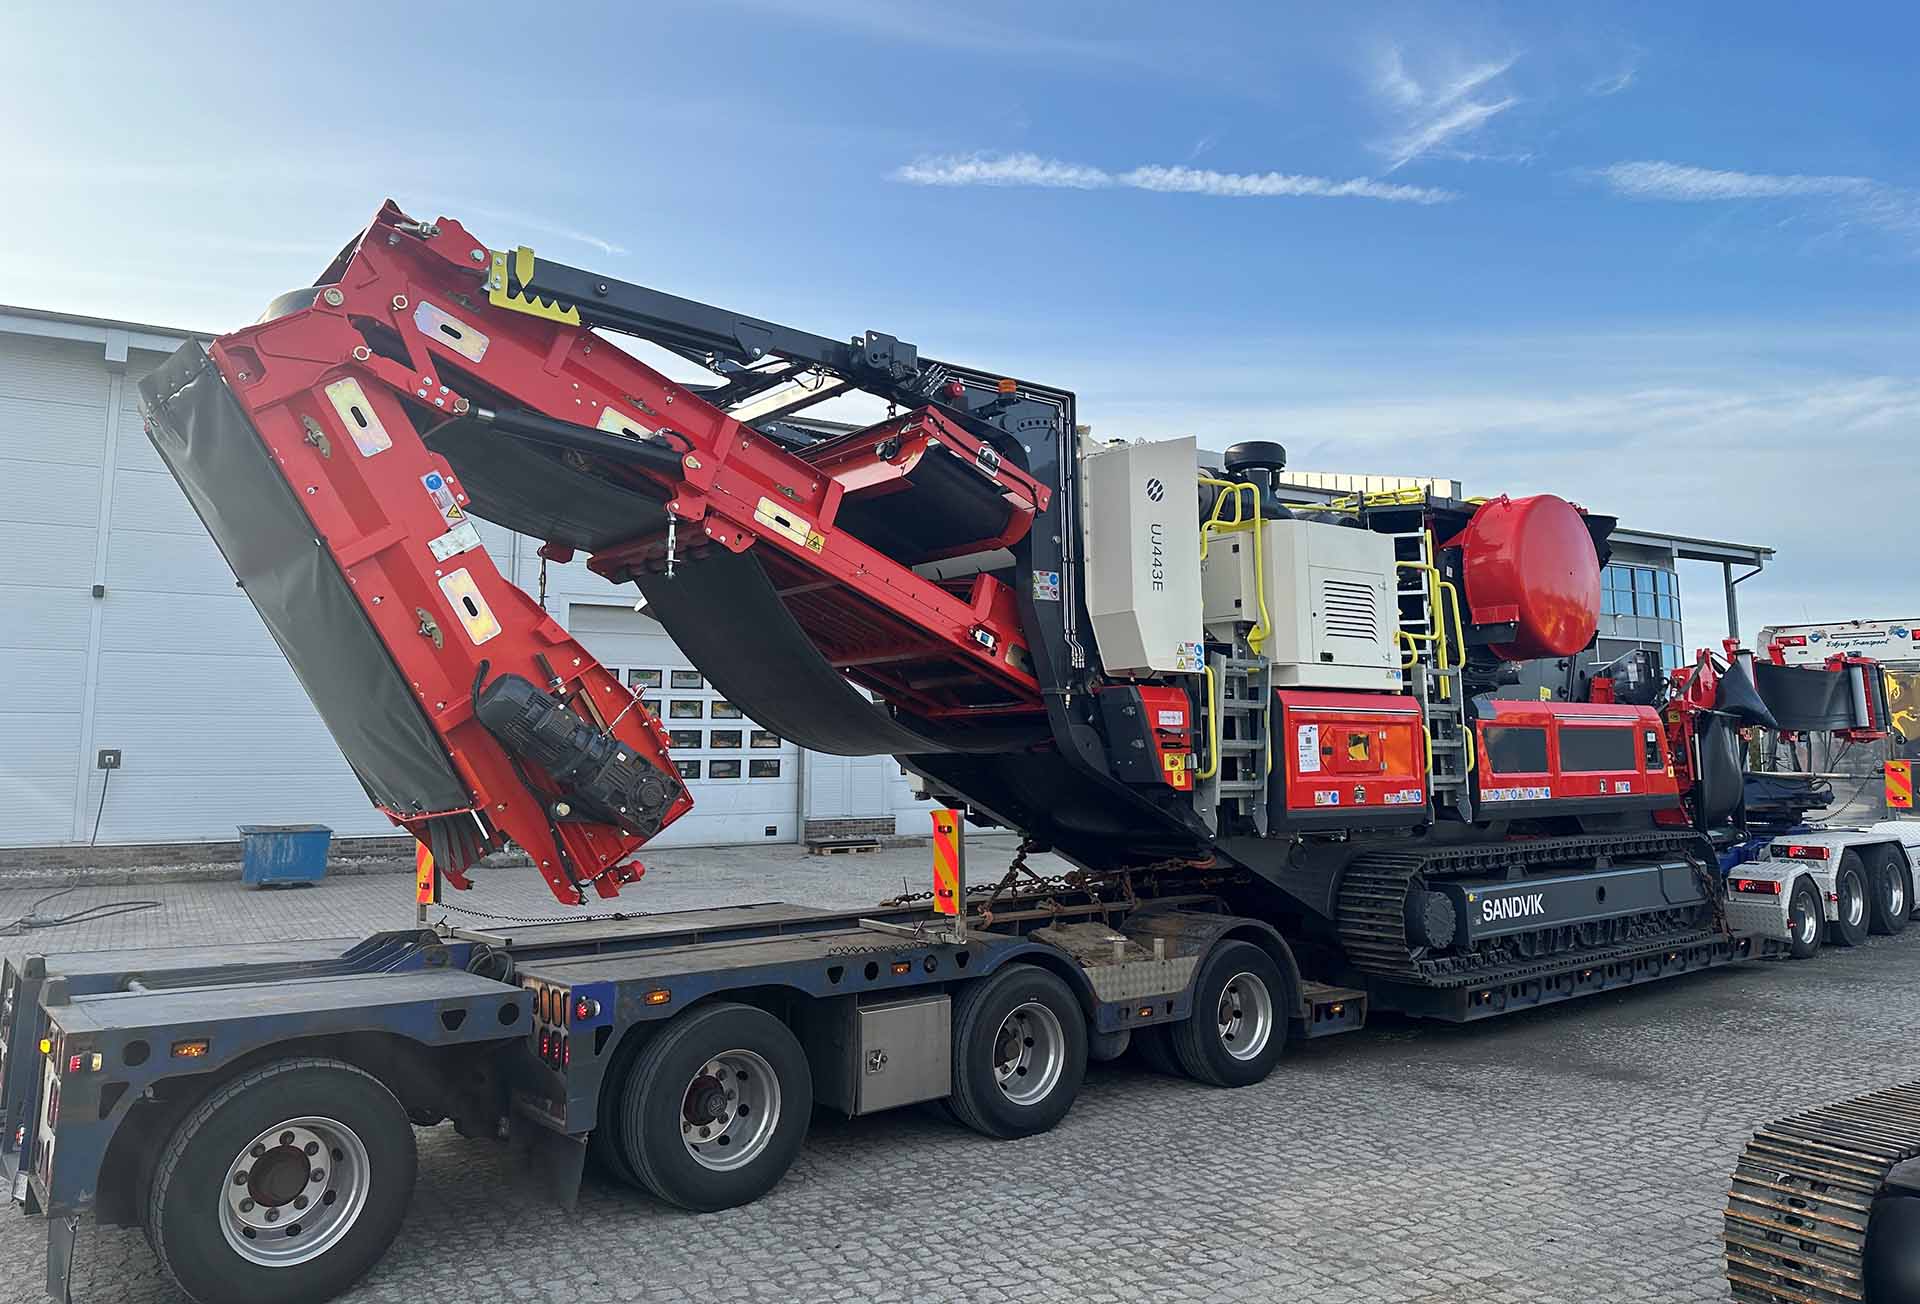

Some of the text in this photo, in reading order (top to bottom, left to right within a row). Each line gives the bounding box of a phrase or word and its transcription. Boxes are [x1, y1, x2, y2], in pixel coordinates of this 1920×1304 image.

[1150, 523, 1164, 592] UJ443E
[1852, 638, 1889, 648] Transport
[1482, 893, 1545, 922] SANDVIK
